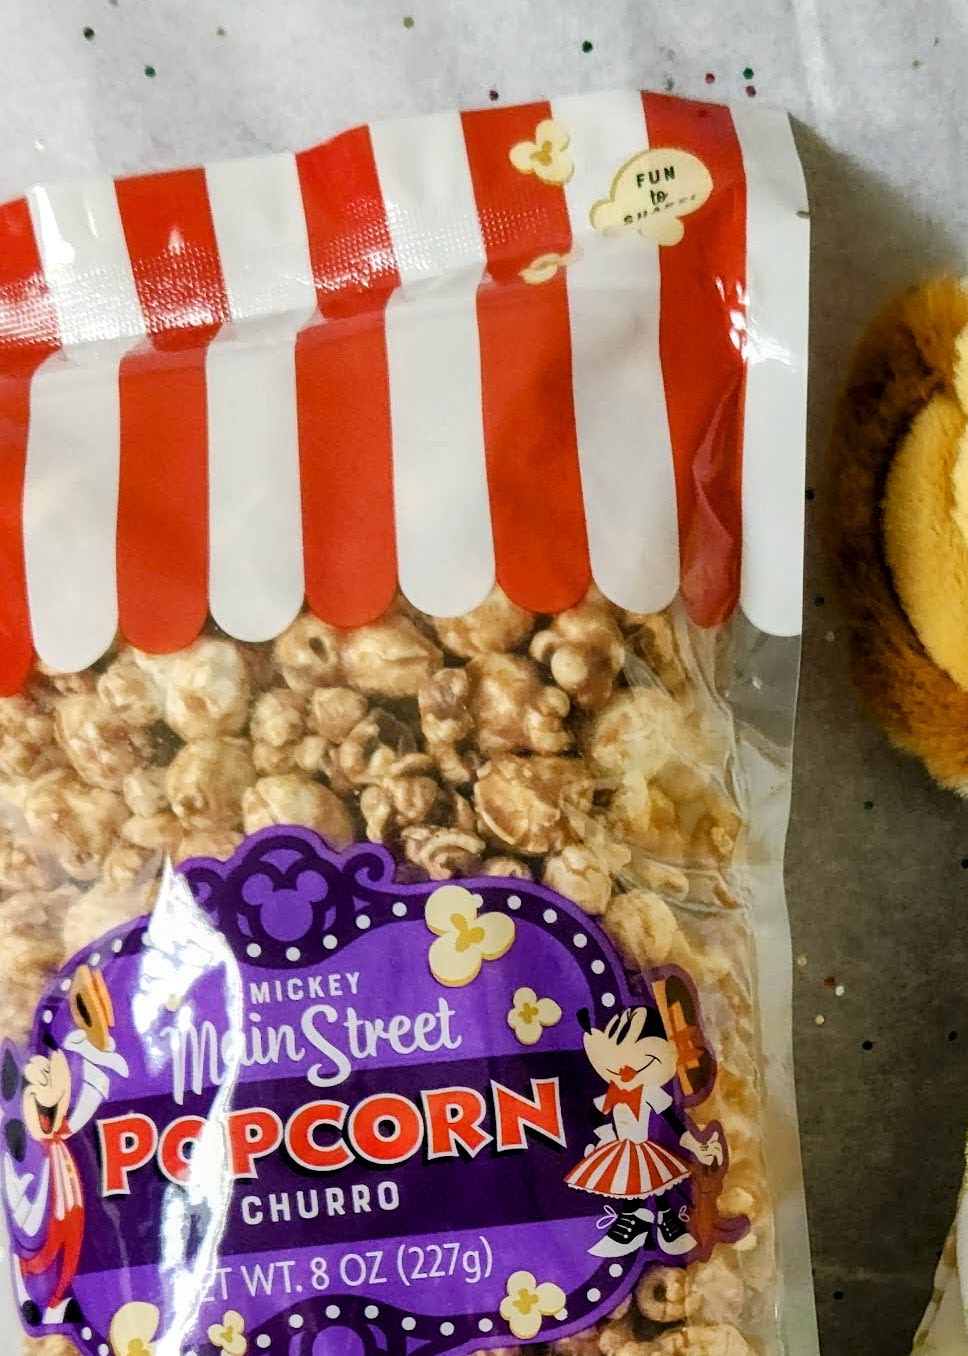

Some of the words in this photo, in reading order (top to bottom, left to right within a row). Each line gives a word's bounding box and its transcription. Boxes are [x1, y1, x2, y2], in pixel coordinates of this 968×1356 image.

[636, 165, 676, 189] FUN
[249, 971, 361, 1004] MICKEY
[300, 997, 463, 1088] Street
[96, 1076, 568, 1198] POPCORN
[240, 1180, 401, 1226] CHURRO
[240, 1259, 303, 1298] WT.
[310, 1256, 331, 1291] 8
[339, 1250, 388, 1287] OZ
[396, 1235, 494, 1287] (227g)
